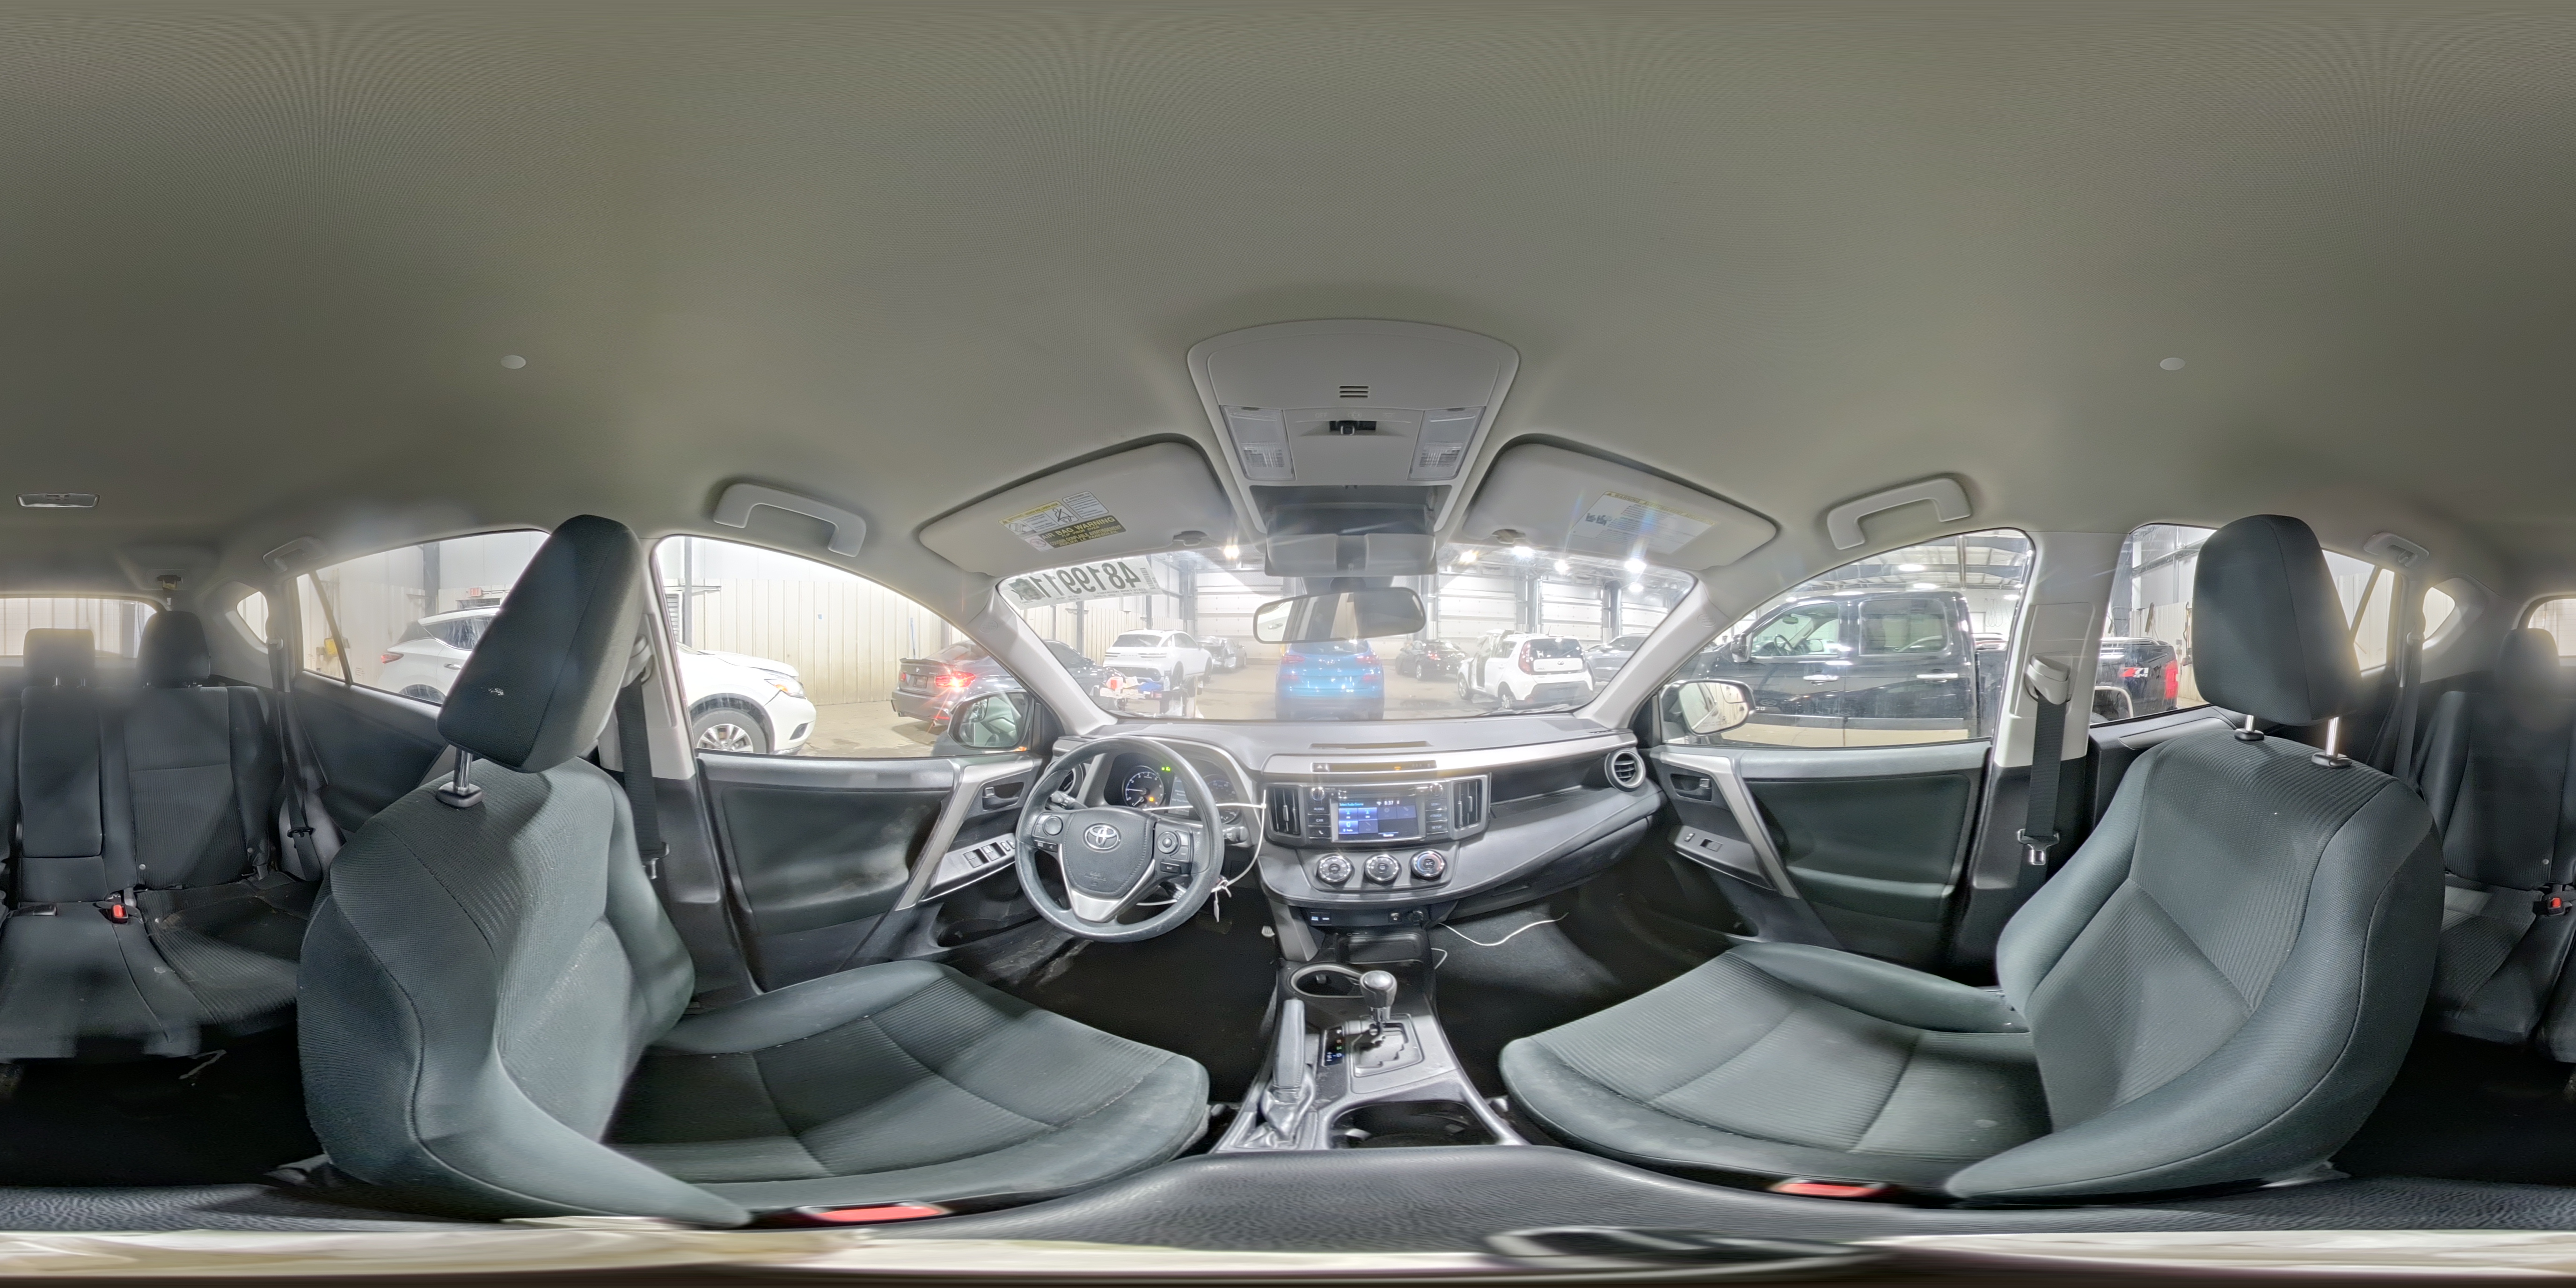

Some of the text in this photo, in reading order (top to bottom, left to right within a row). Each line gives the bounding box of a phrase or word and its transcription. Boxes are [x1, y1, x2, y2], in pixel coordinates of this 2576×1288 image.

[1615, 494, 1639, 503] WARNING
[1074, 516, 1116, 530] WARNING
[2119, 667, 2149, 677] Z71
